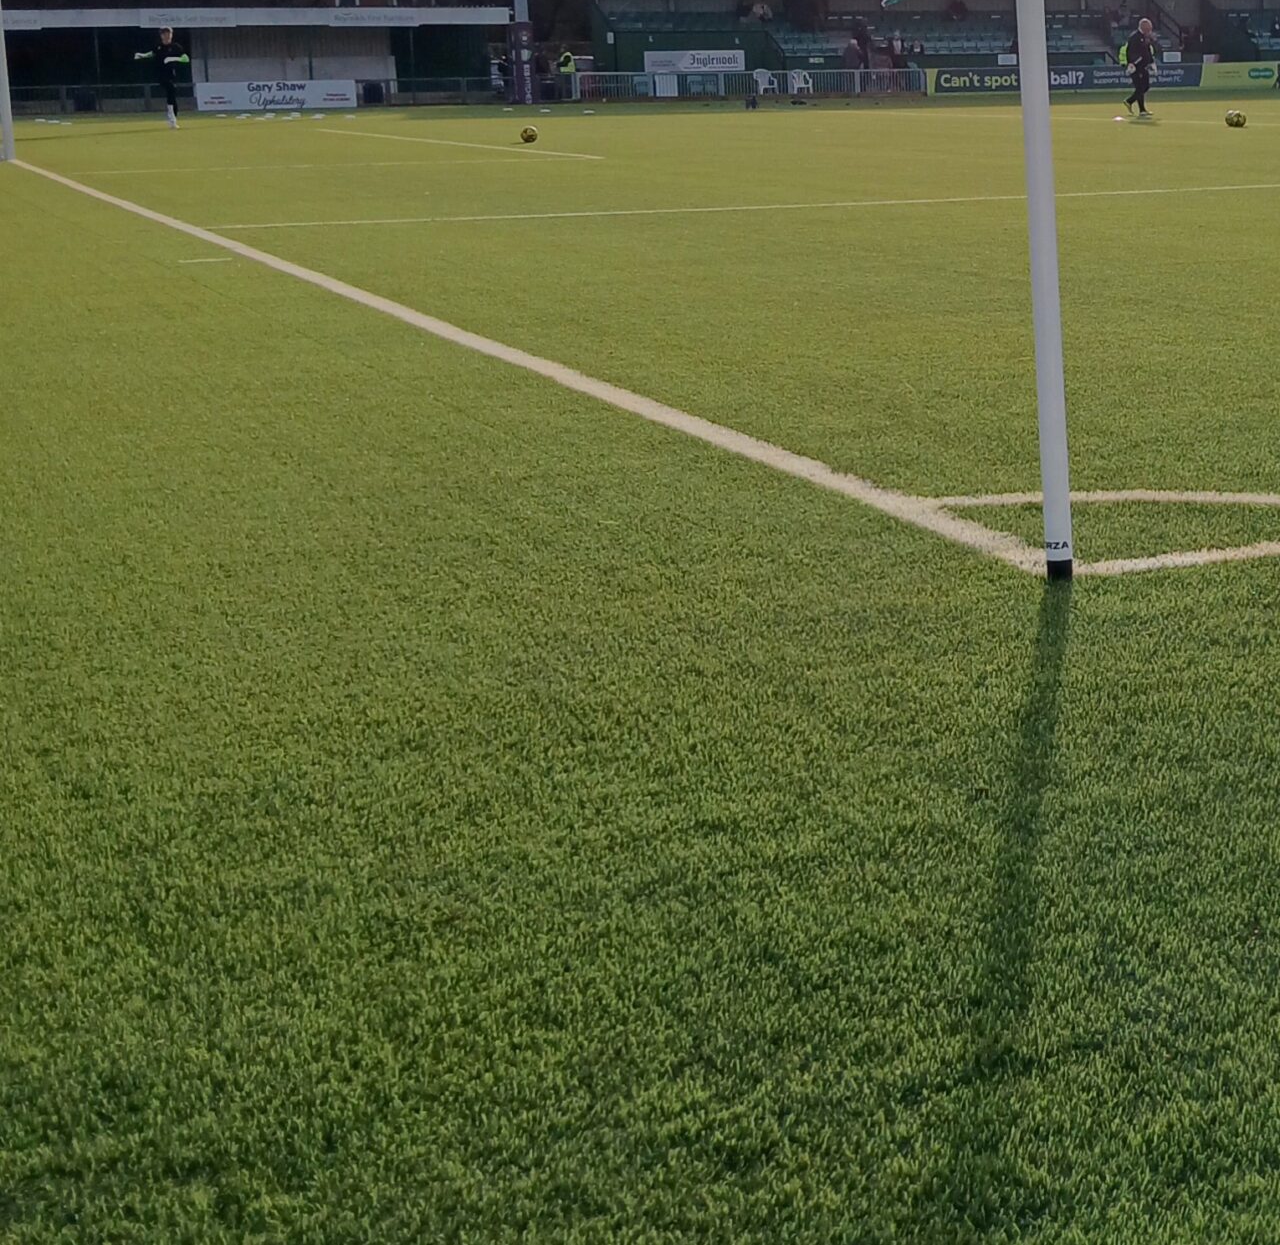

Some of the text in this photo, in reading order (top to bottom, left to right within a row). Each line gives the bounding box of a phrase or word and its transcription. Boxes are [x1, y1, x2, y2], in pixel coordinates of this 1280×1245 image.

[247, 81, 307, 93] Gary Shaw
[940, 71, 1085, 90] Can't spot ball?
